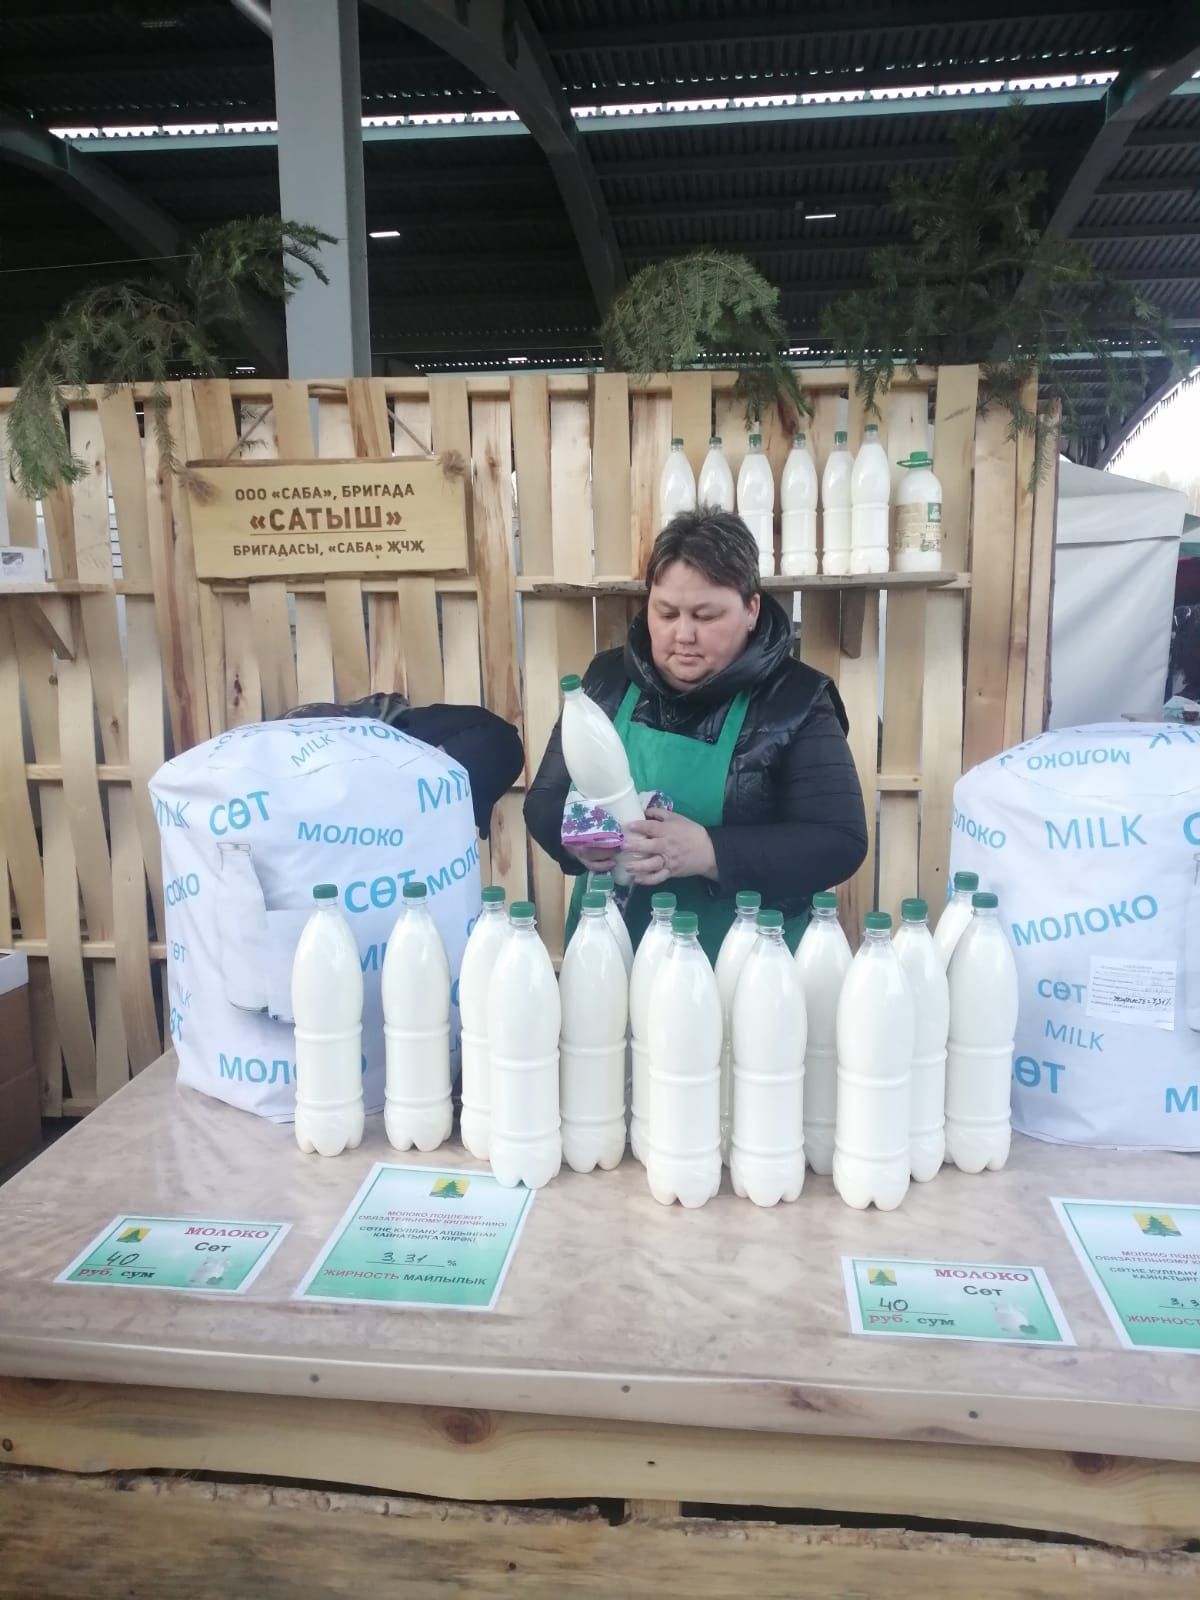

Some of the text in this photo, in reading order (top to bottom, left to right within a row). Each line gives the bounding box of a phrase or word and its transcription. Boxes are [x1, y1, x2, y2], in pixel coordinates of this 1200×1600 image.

[235, 484, 415, 501] ООО «САБА», БРИГАДА
[250, 506, 402, 531] «САТЫШ»
[233, 543, 323, 556] БРИГАДАСЫ,
[328, 542, 382, 553] «САБА»
[290, 734, 336, 768] MILK
[1027, 748, 1131, 771] МОЛОКО
[209, 791, 270, 836] СӨТ
[298, 821, 404, 847] МОЛОКО
[1044, 814, 1148, 850] MILK
[1011, 895, 1159, 947] МОЛОКО
[1038, 979, 1087, 1003] СӨТ
[1045, 1019, 1105, 1052] MILK
[1014, 1055, 1066, 1094] ӨТ
[184, 1227, 269, 1239] МОЛОКО
[194, 1242, 232, 1252] Сөт
[106, 1252, 139, 1266] 40
[121, 1270, 156, 1278] сум
[324, 1269, 487, 1285] ЖИРНОСТЬ МАЙЛЫЛЫК
[934, 1268, 1029, 1282] МОЛОКО
[963, 1285, 1004, 1297] Сөт
[879, 1297, 909, 1312] 40
[917, 1317, 955, 1327] сум
